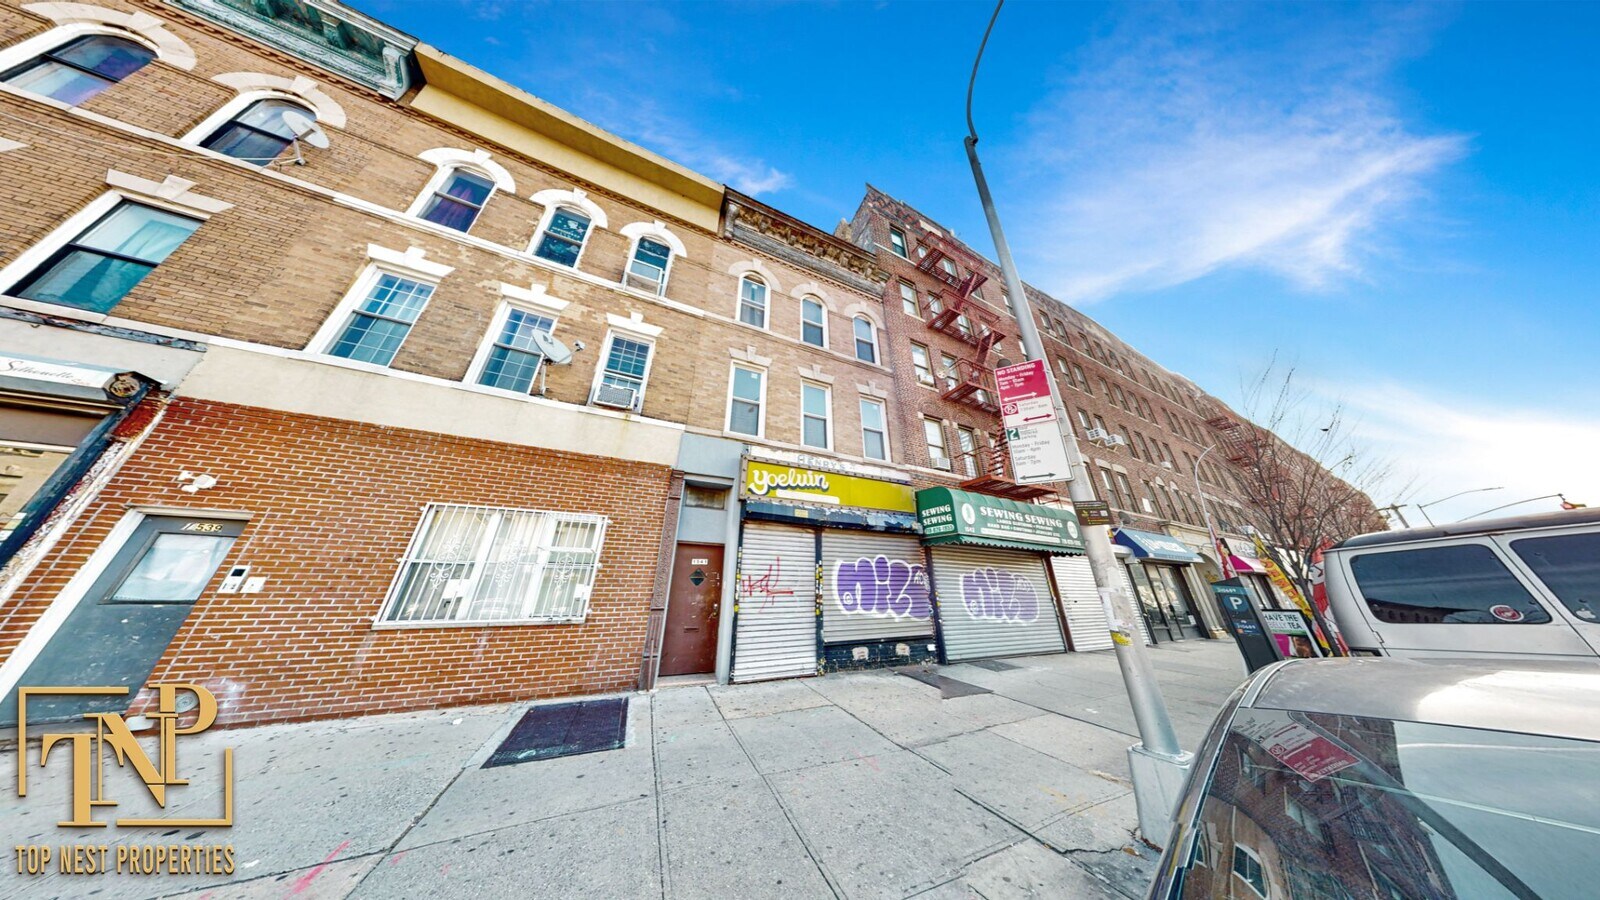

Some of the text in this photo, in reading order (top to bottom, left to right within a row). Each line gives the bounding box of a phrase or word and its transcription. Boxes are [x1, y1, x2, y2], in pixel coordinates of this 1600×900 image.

[1006, 363, 1036, 373] STANDING
[1009, 429, 1019, 440] 2
[921, 504, 952, 518] SEWING
[980, 506, 1063, 527] SEWING SEWING
[923, 513, 953, 527] SEWING
[1229, 596, 1243, 610] P
[1283, 614, 1299, 622] THE
[1287, 622, 1303, 630] TEA
